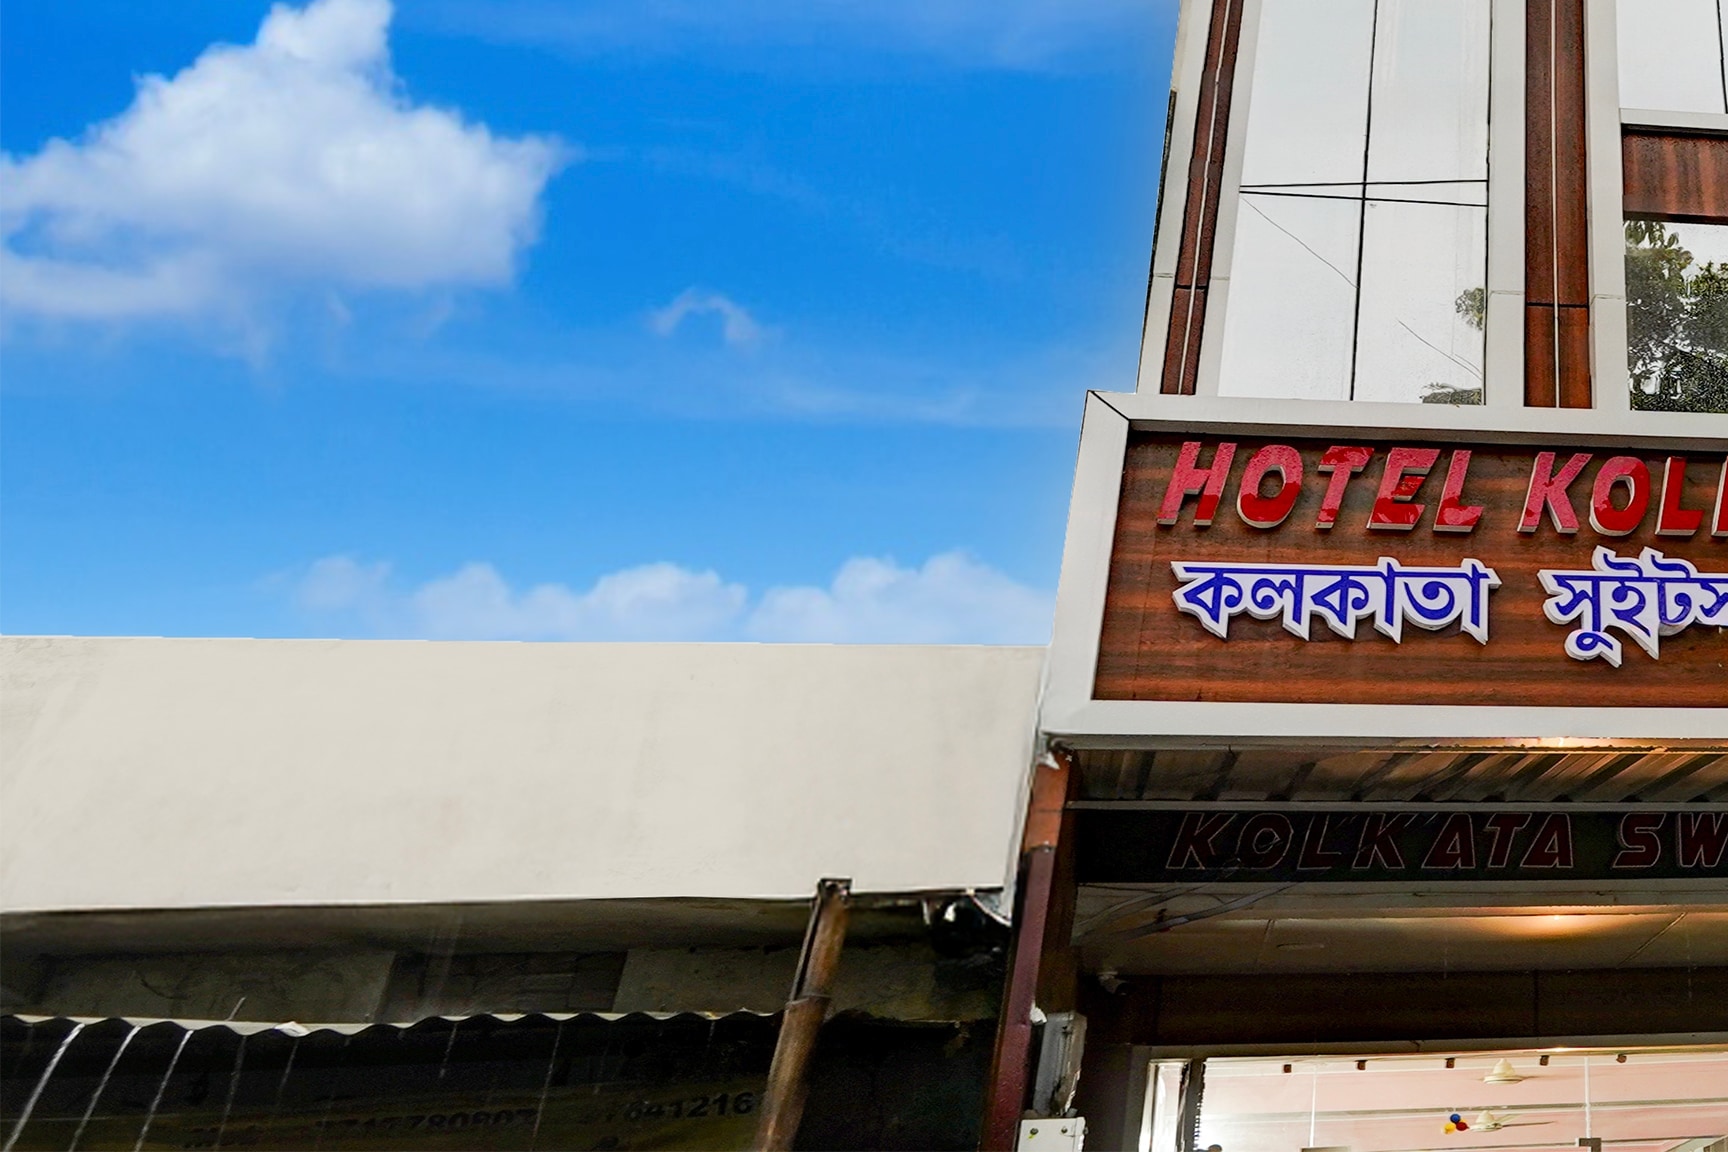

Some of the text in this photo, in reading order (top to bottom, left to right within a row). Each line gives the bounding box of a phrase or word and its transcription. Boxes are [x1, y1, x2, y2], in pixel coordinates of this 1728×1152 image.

[1157, 441, 1484, 534] HOTEL
[1174, 559, 1498, 639] কলকাতা
[1165, 812, 1574, 870] KOLKATA
